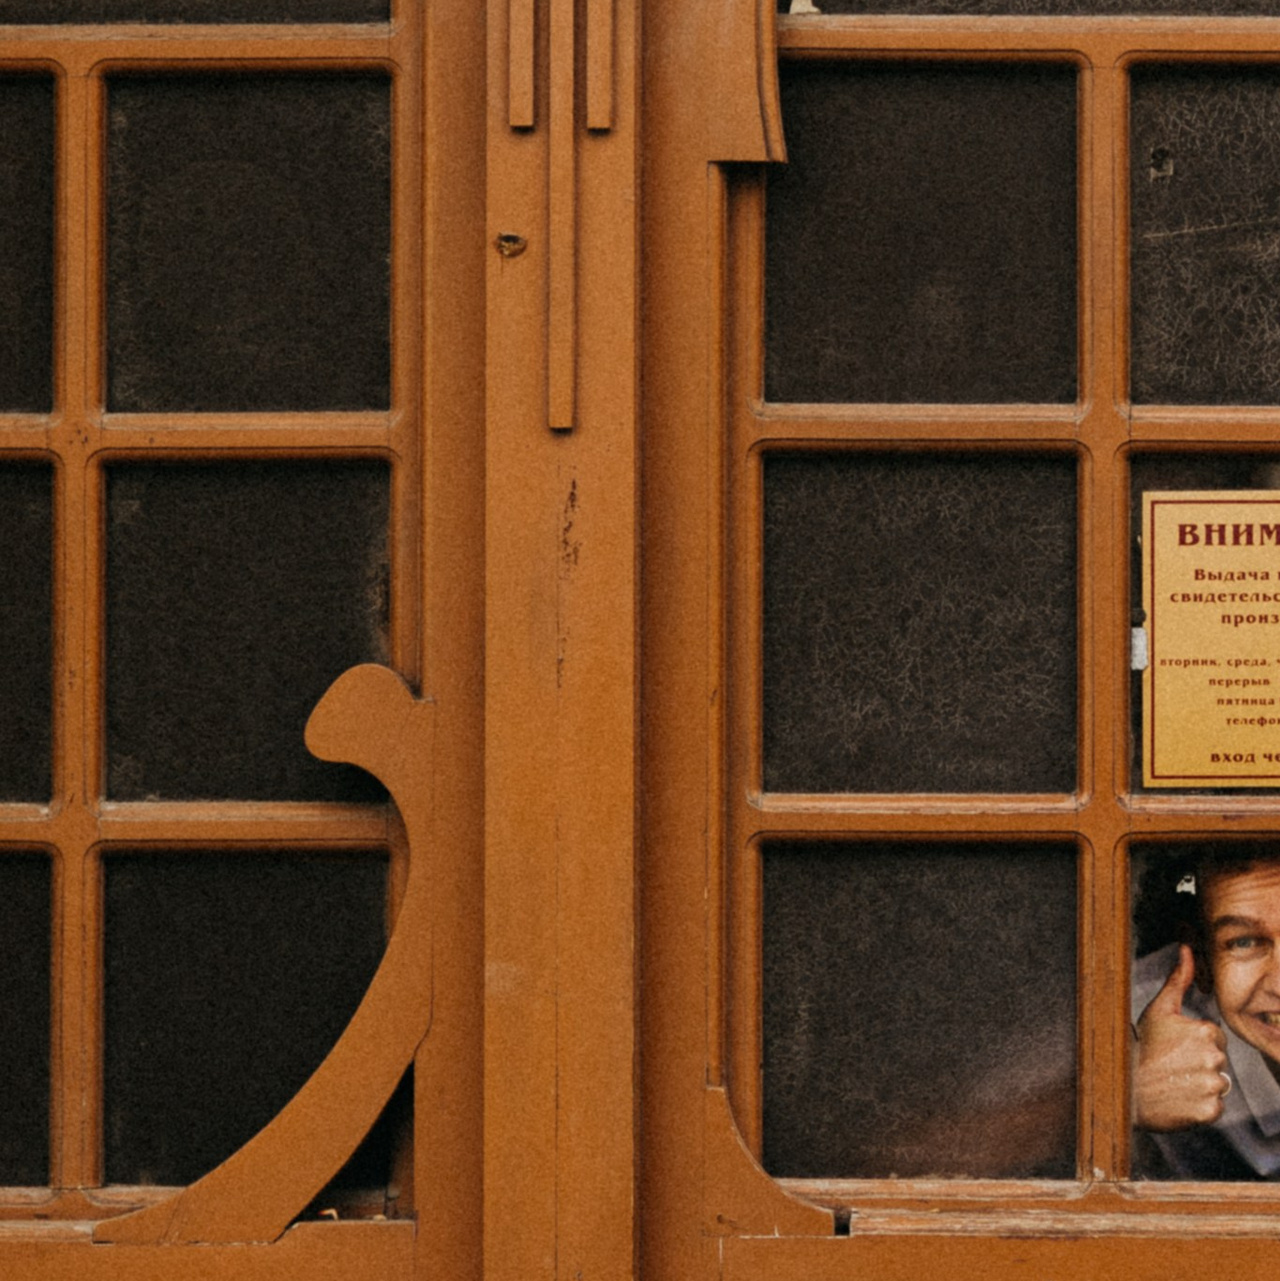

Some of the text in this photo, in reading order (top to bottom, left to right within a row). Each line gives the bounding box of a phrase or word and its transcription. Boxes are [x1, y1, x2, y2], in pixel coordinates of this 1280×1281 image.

[1194, 568, 1270, 582] Выдача
[1208, 678, 1271, 689] перерыв
[1216, 698, 1276, 706] пятница
[1210, 753, 1256, 764] вход
